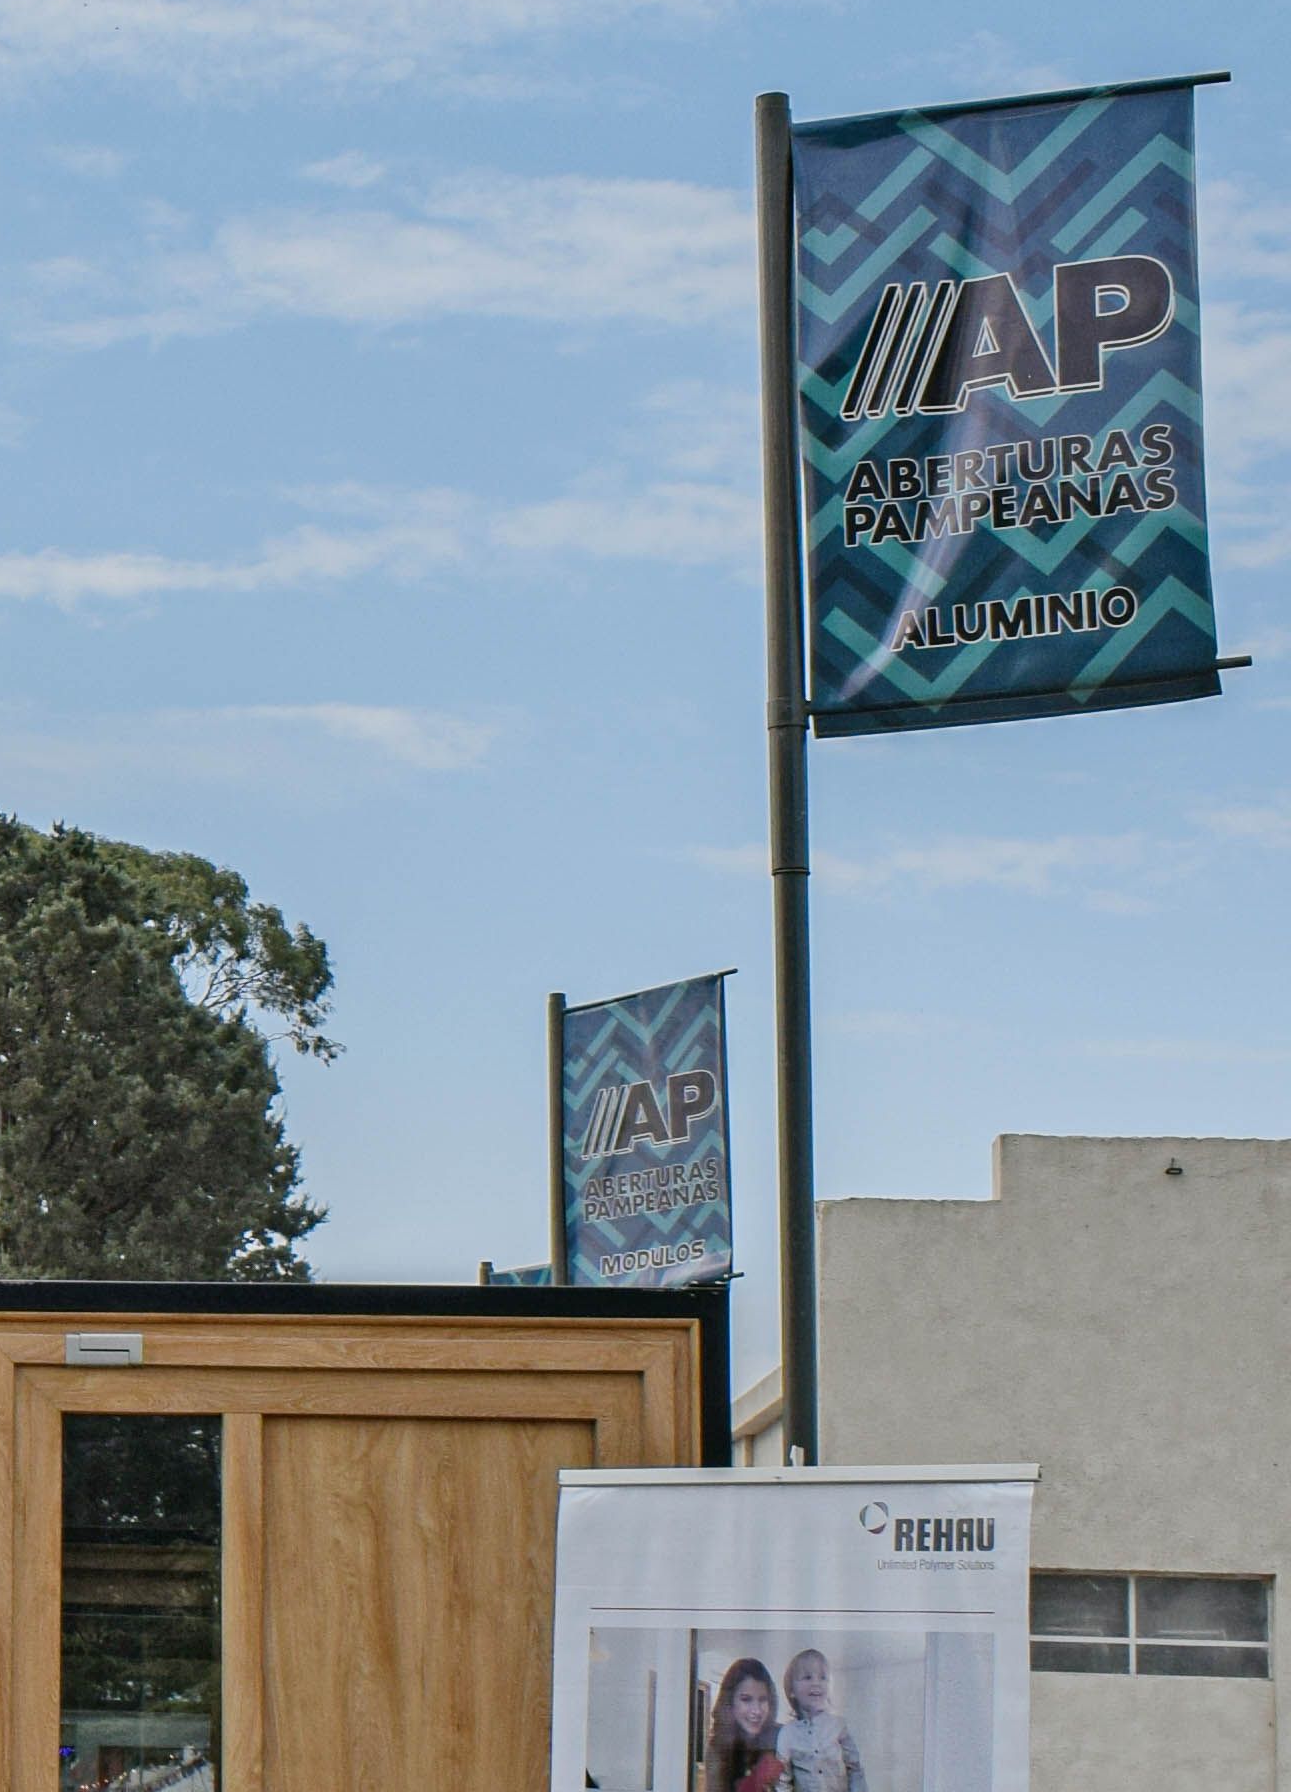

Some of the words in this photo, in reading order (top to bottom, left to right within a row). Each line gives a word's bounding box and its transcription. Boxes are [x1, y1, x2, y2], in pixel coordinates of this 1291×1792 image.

[845, 425, 1174, 503] ABERTURAS
[844, 468, 1177, 548] PAMPEANAS
[892, 586, 1138, 652] ALUMINIO
[584, 1158, 717, 1201] ABERTURAS
[583, 1180, 719, 1223] PAMPEANAS
[600, 1239, 706, 1277] MODULOS
[894, 1517, 995, 1552] REHAU
